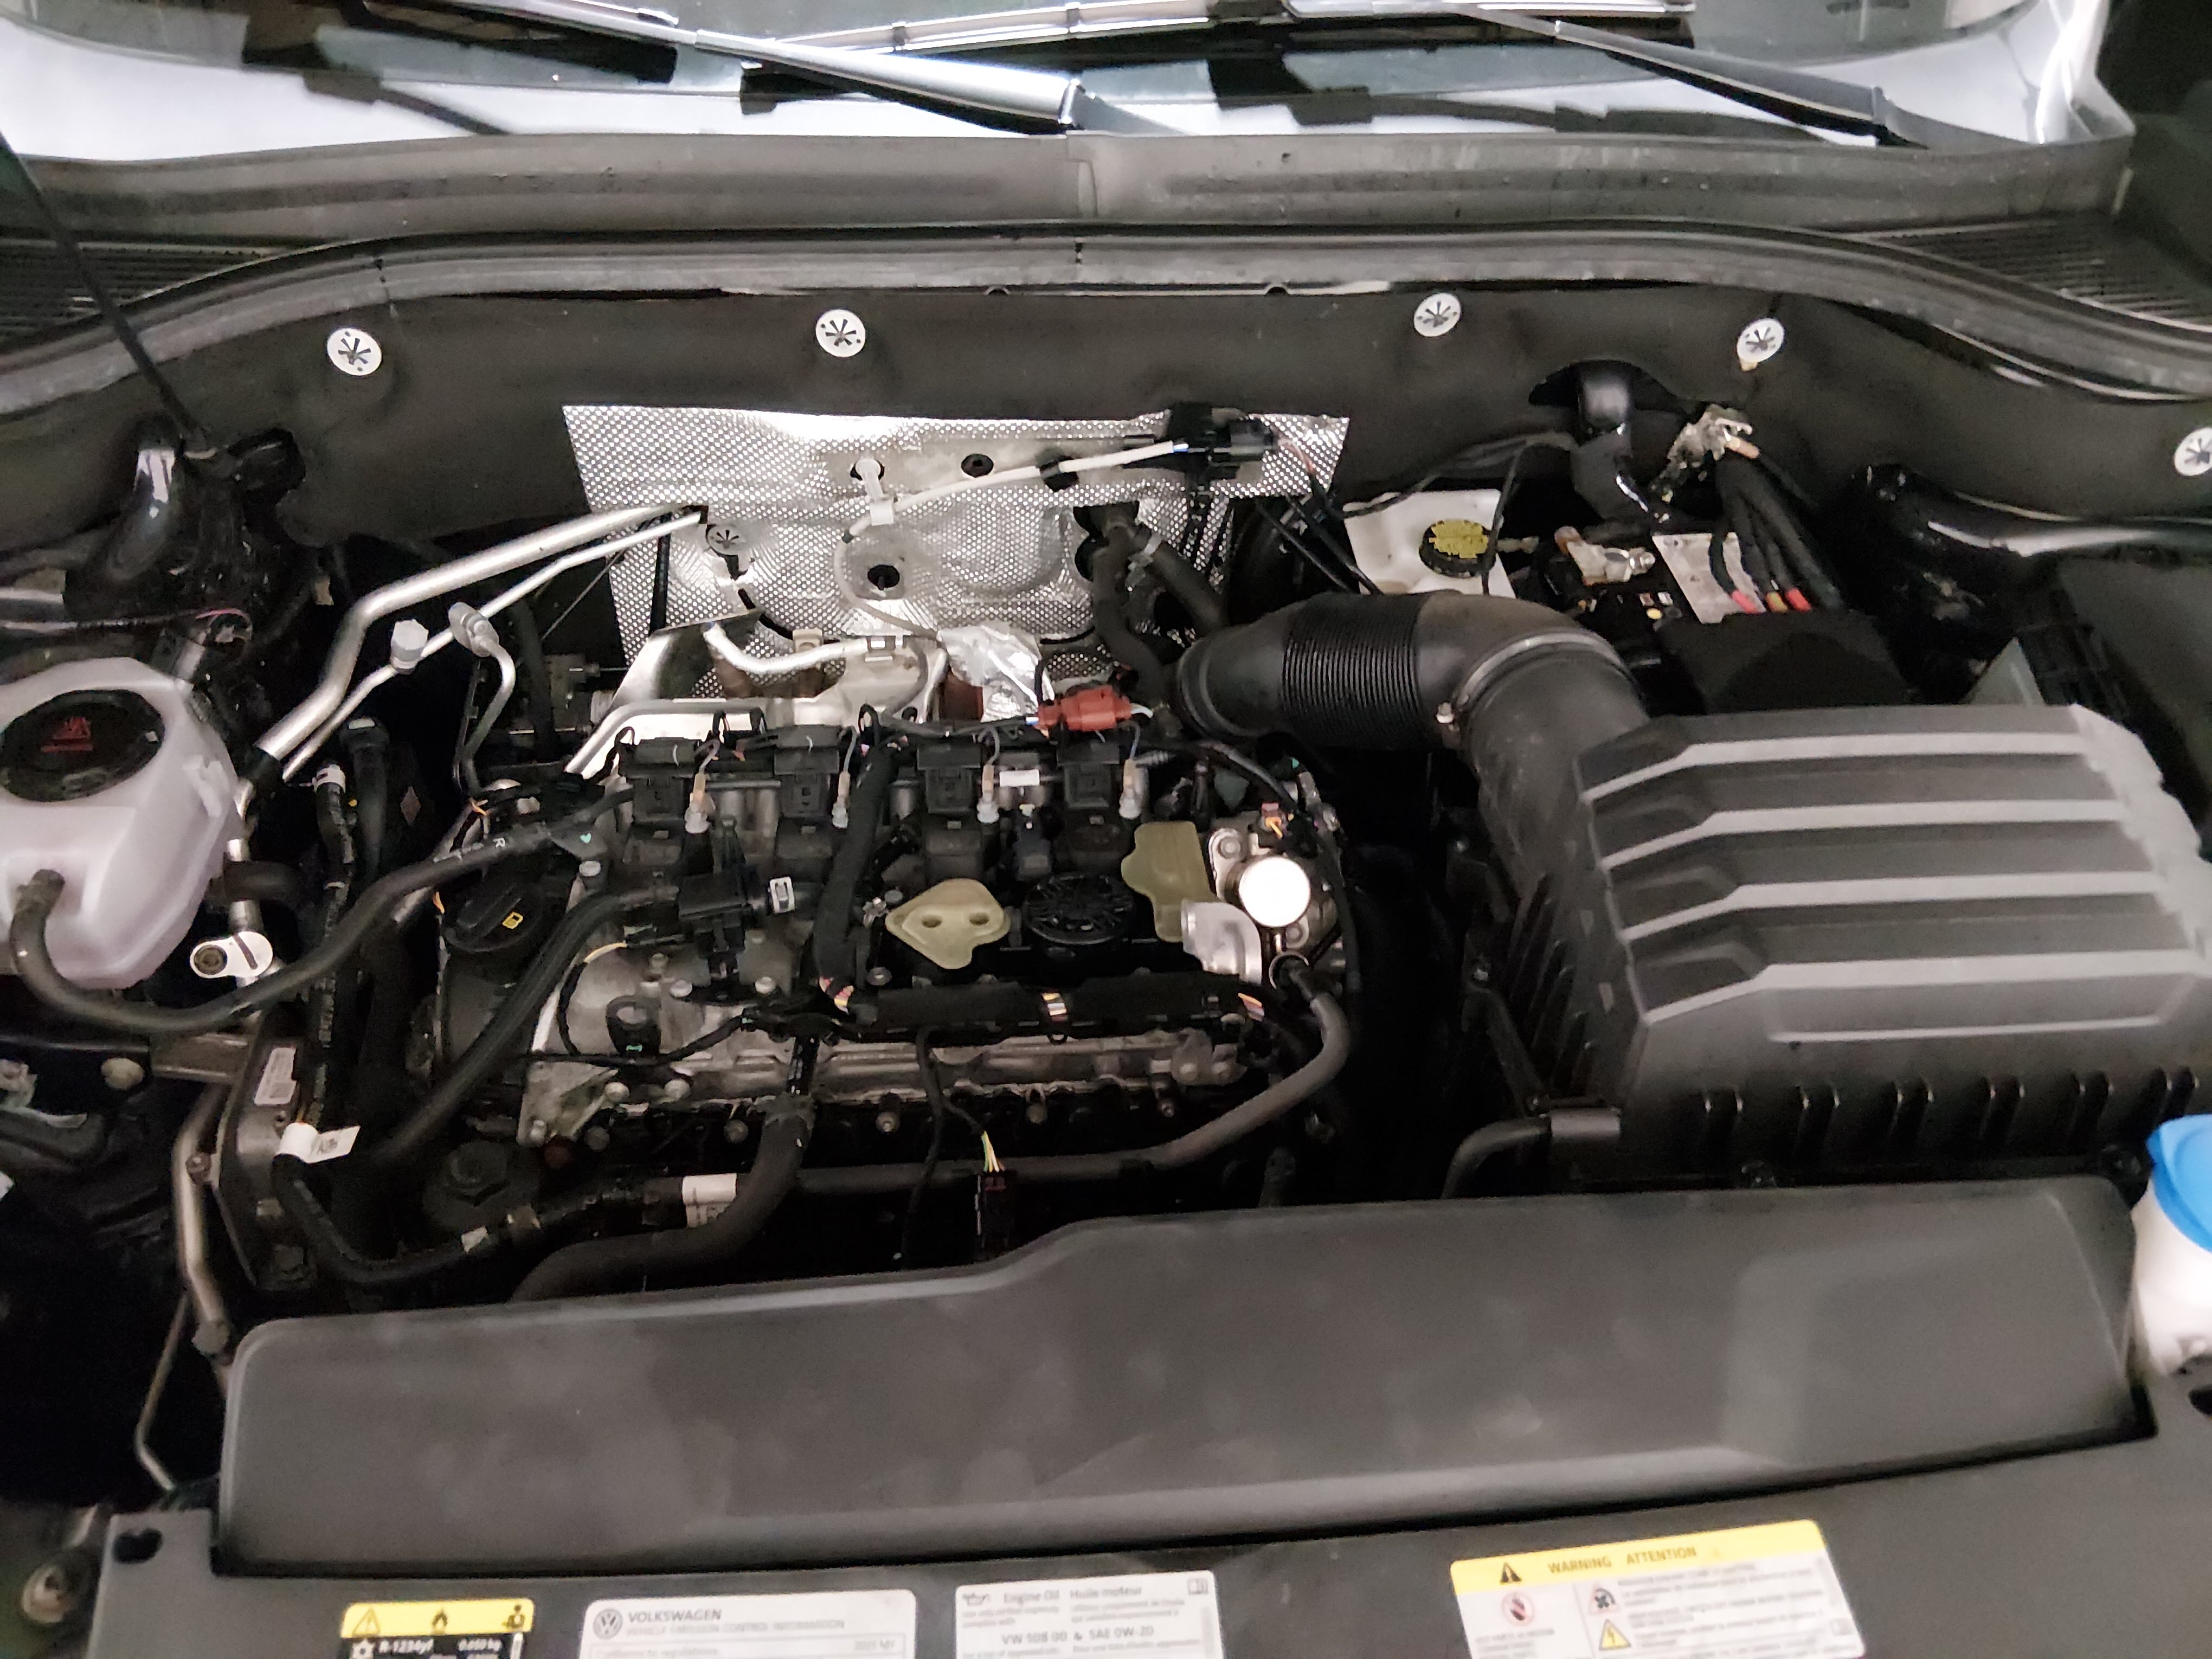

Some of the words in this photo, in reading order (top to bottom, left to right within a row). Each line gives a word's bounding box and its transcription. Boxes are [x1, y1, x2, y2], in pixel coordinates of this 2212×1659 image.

[1548, 1555, 1612, 1573] WARNING
[1626, 1546, 1697, 1565] ATTENTION
[1004, 1592, 1041, 1606] Engine
[1043, 1590, 1060, 1600] Oil
[1070, 1588, 1098, 1599] Huile
[1102, 1585, 1142, 1597] moteur
[628, 1609, 722, 1623] VOLKSWAGEN
[1001, 1634, 1023, 1645] VW
[1026, 1631, 1048, 1643] 508
[1089, 1627, 1111, 1639] SAE
